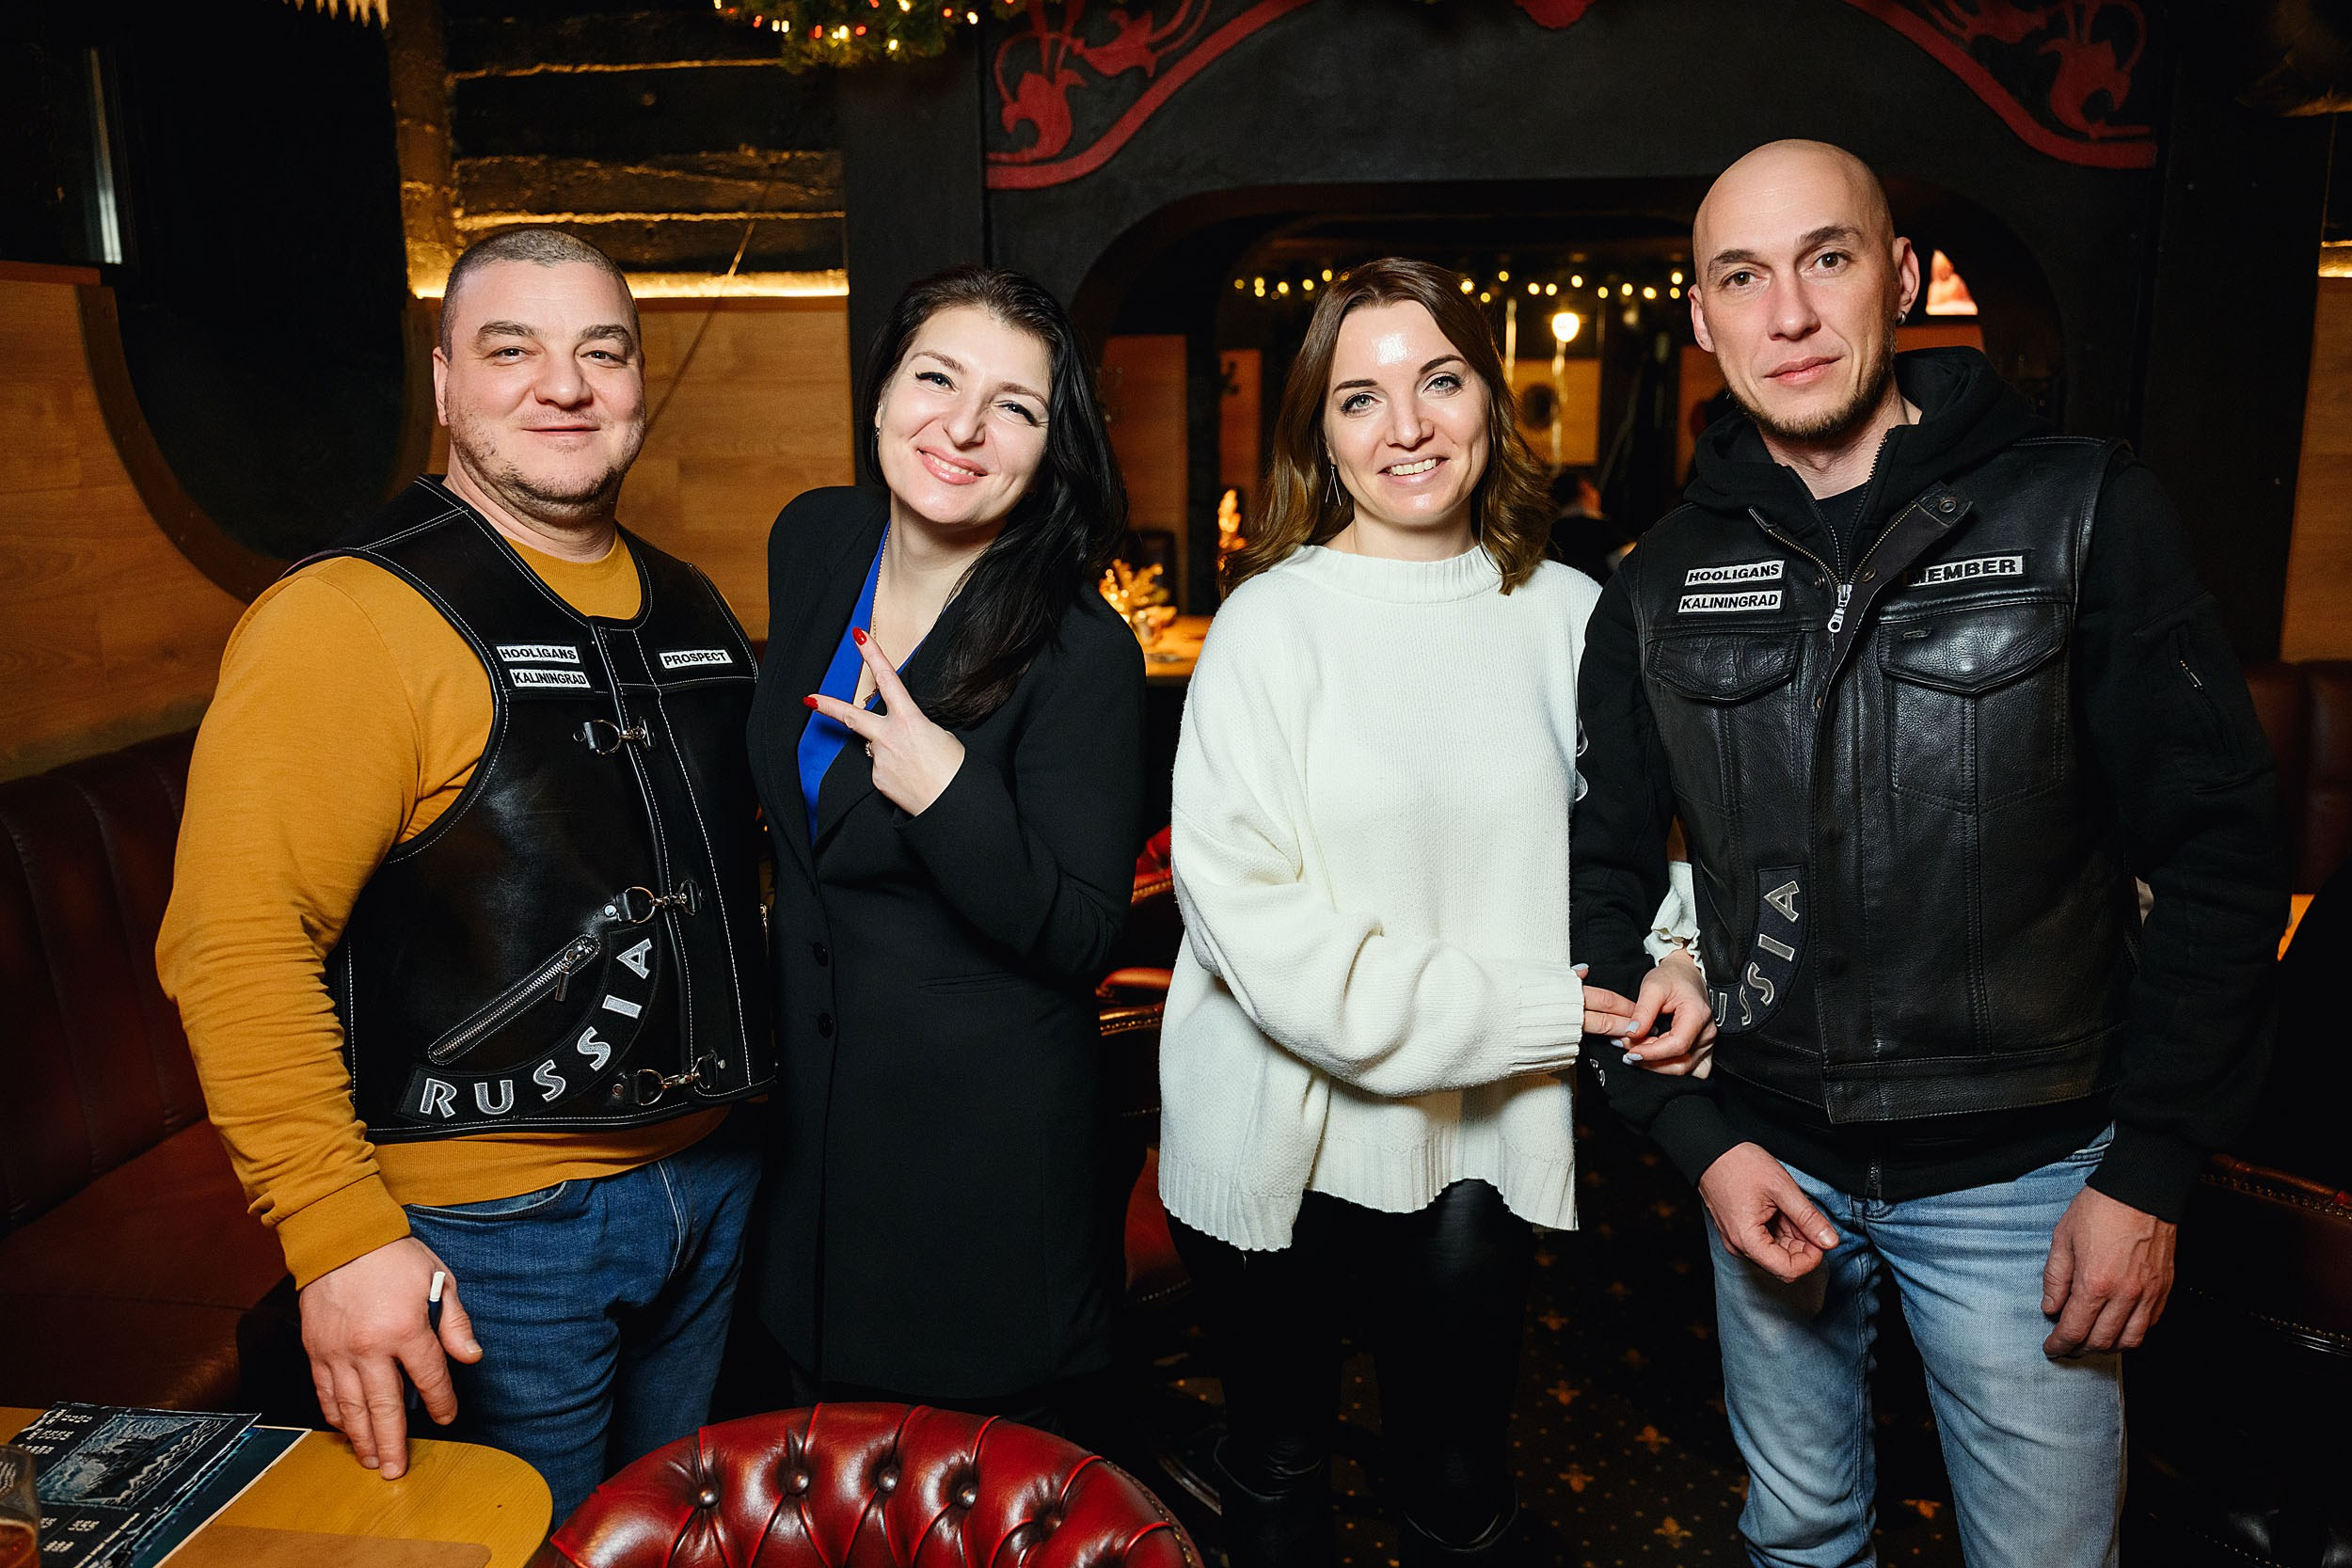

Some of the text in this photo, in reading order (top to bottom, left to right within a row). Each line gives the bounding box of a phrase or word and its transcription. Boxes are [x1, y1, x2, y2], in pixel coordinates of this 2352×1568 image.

[1687, 563, 1780, 582] HOOLIGANS
[1680, 594, 1778, 610] KALININGRAD
[499, 647, 577, 660] HOOLIGANS
[663, 651, 727, 666] PROSPECT
[514, 672, 587, 686] KALININGRAD
[1708, 880, 1800, 1027] USSIA
[419, 937, 653, 1118] RUSSIA
